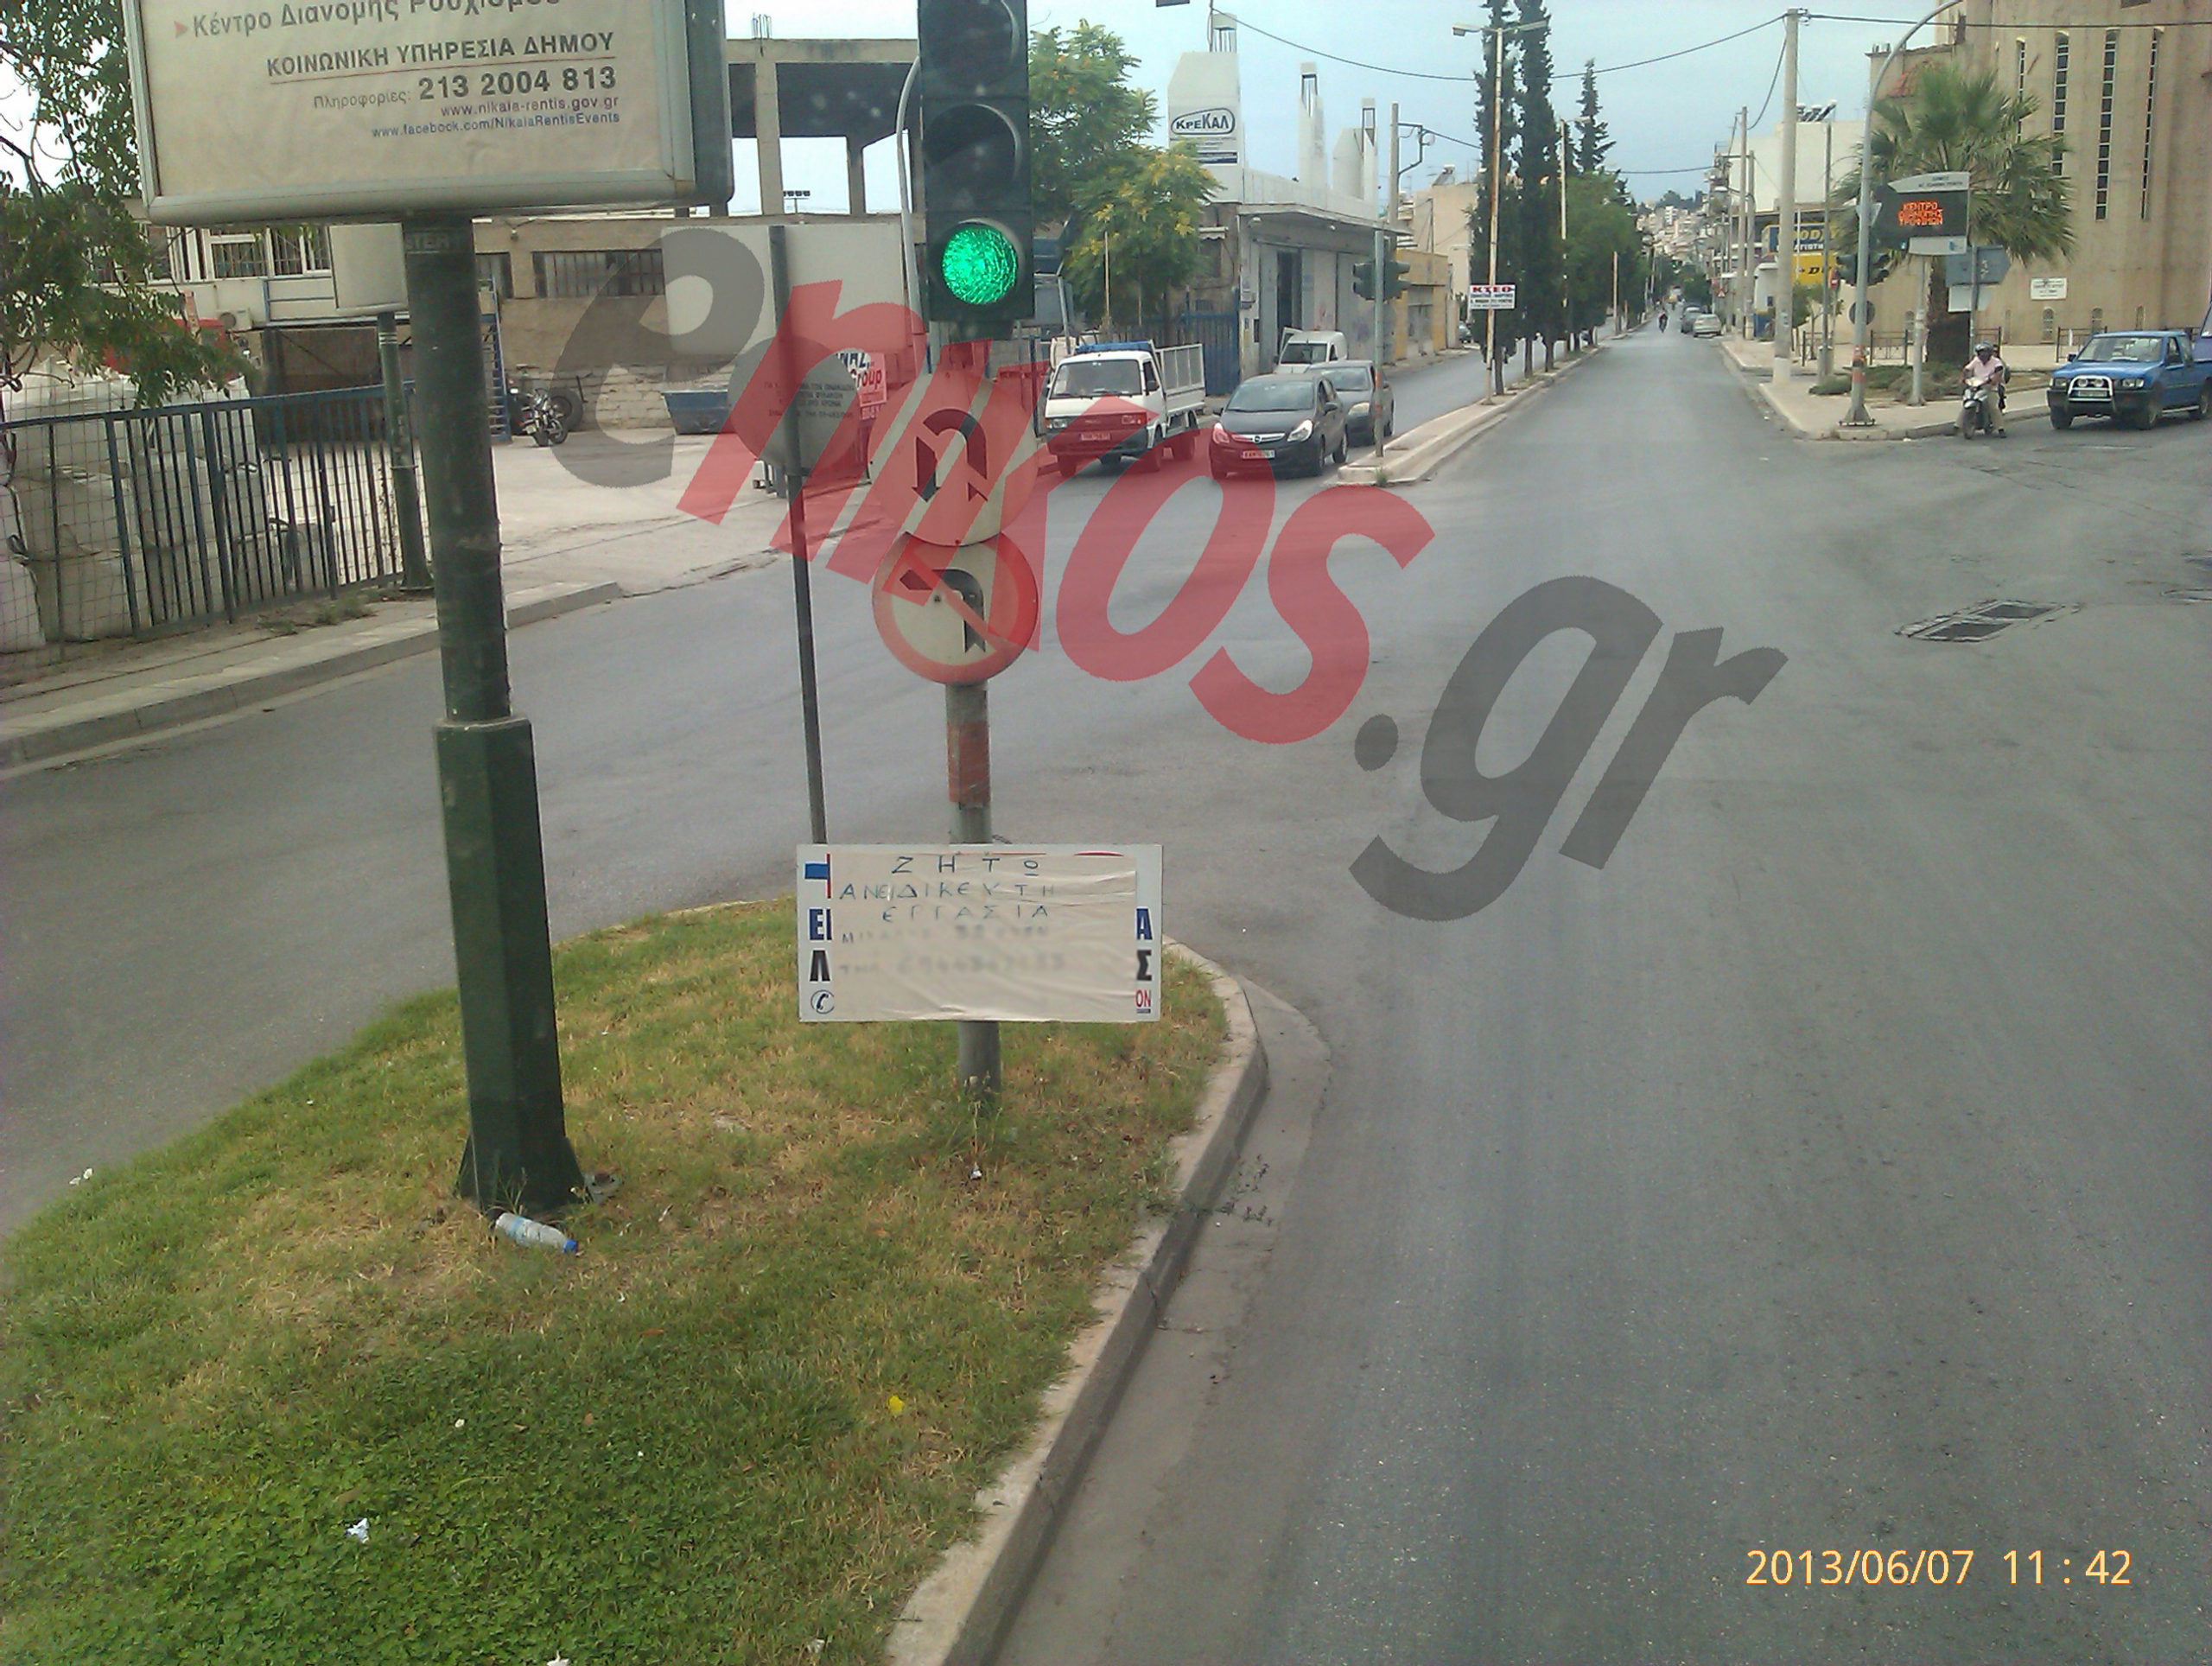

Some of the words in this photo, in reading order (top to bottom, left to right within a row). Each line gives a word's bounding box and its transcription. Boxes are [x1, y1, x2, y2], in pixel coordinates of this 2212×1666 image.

[194, 11, 272, 37] Κέντρο
[267, 47, 389, 77] ΚΟΙΝΩΝΙΚΗ
[397, 37, 516, 64] ΥΠΗΡΕΣΙΑ
[524, 31, 614, 55] ΔΗΜΟΥ
[418, 74, 470, 101] 213
[480, 69, 551, 97] 2004
[563, 66, 616, 92] 813
